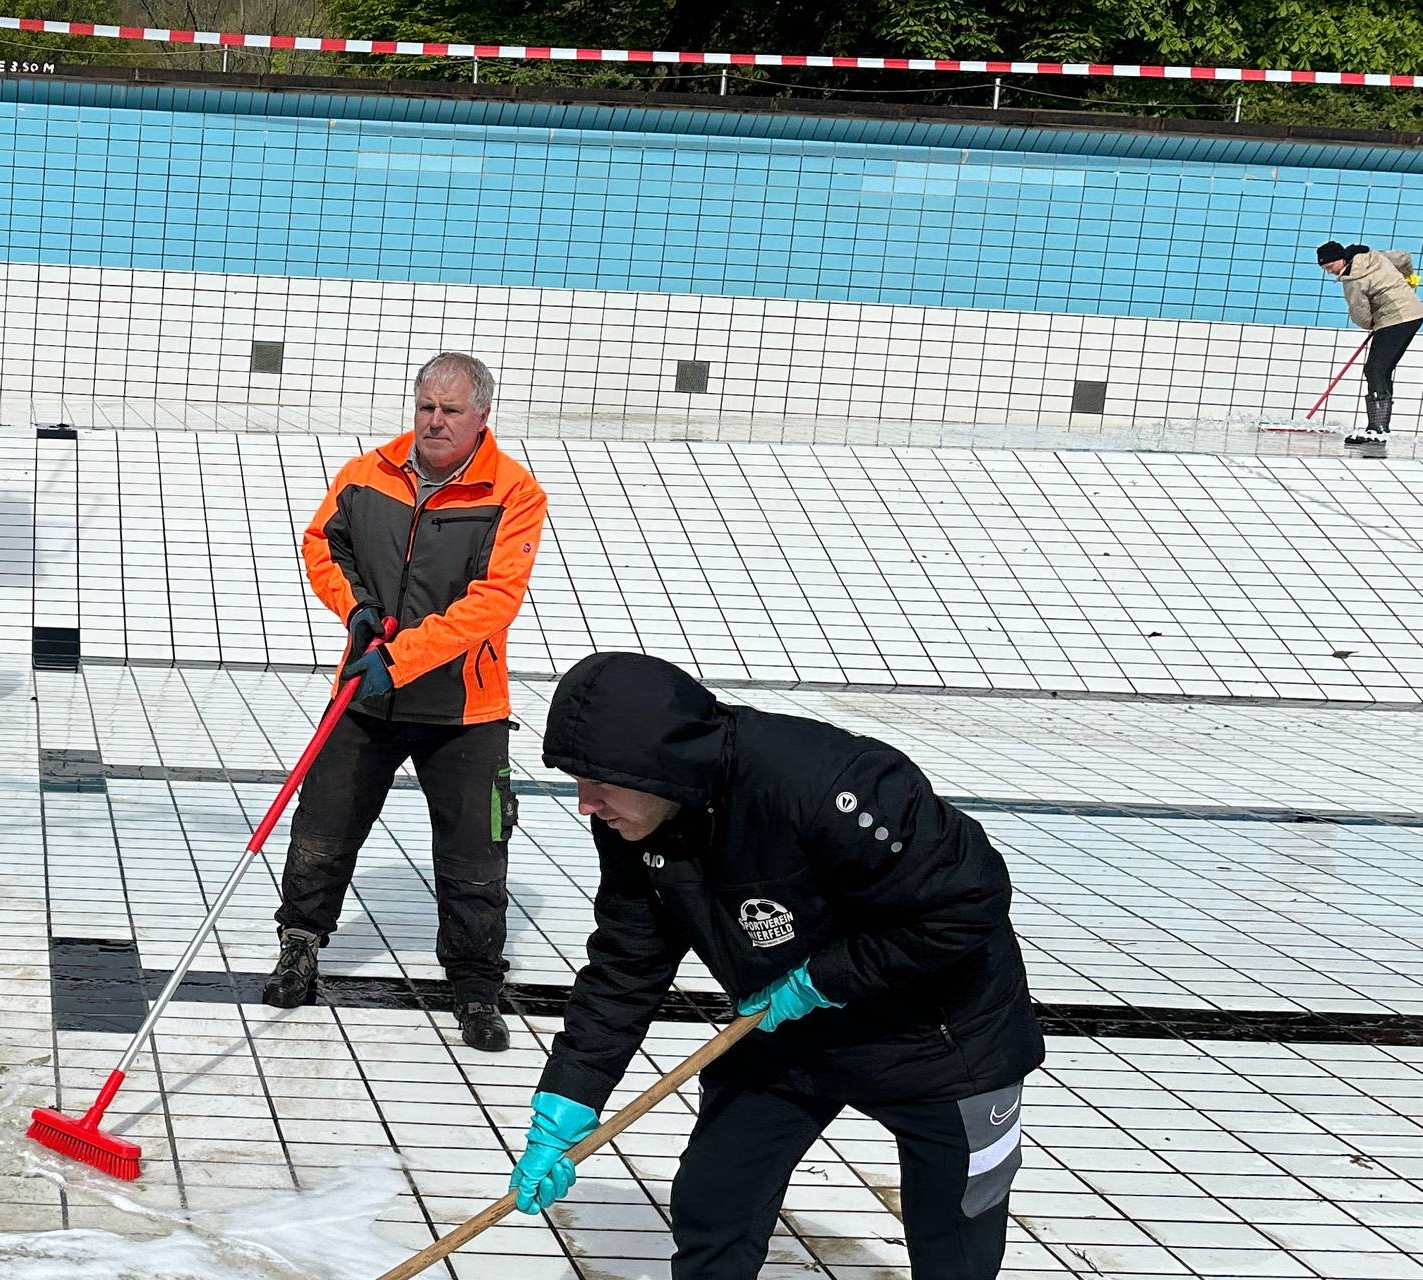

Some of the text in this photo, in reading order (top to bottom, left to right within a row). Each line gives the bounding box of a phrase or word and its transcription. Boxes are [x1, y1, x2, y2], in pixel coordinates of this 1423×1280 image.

[10, 61, 39, 73] 3.50
[43, 62, 55, 74] M
[738, 911, 794, 931] SPORTVEREIN
